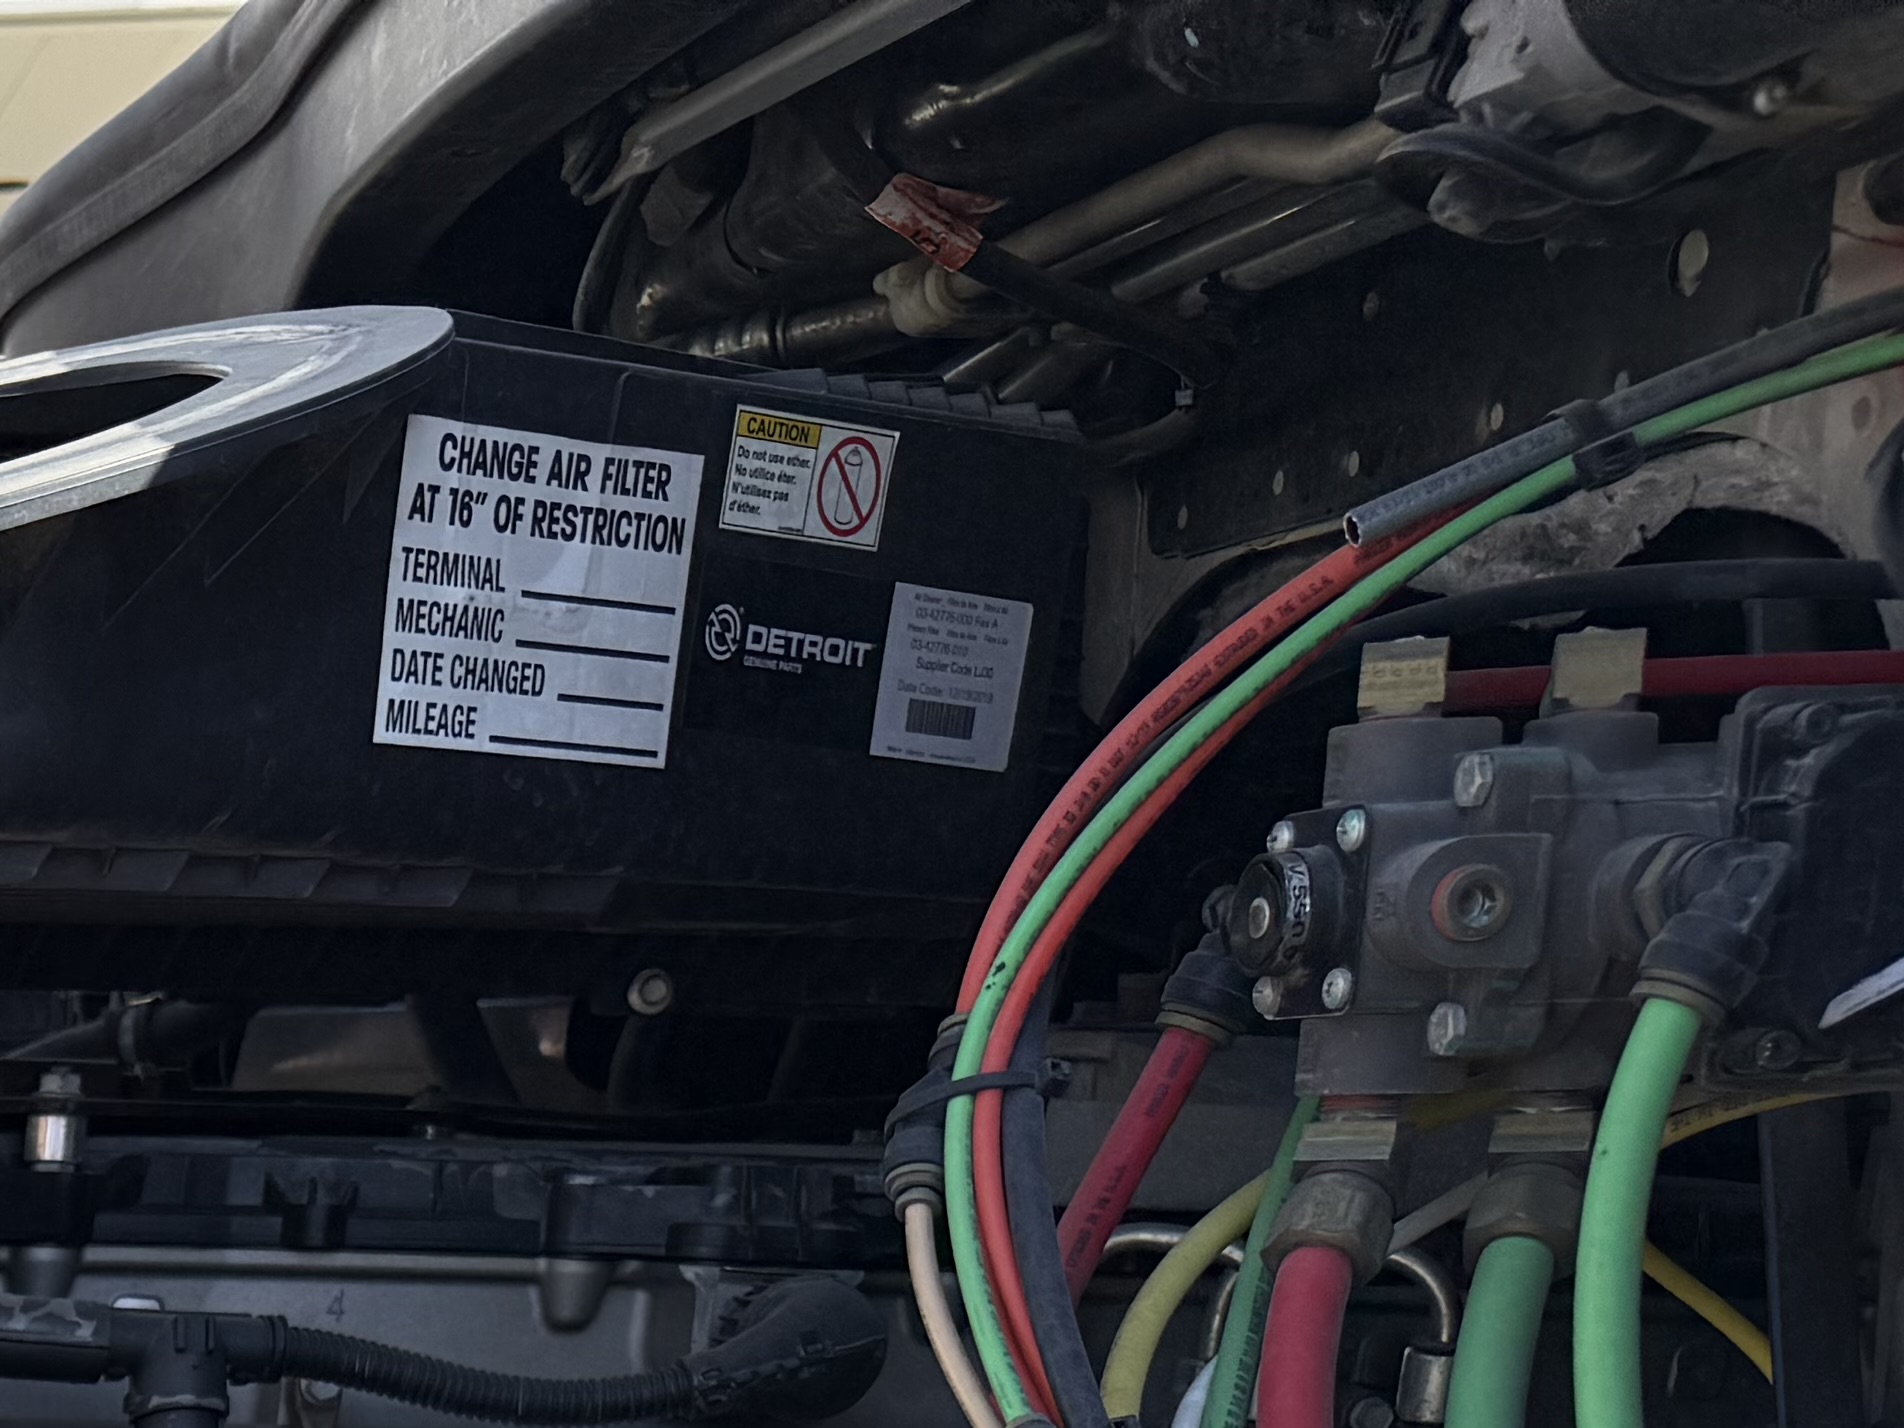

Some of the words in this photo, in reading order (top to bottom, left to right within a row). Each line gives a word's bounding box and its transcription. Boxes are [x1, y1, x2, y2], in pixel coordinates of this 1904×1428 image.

[747, 417, 811, 444] CAUTION
[438, 432, 540, 484] CHANGE
[546, 449, 592, 492] AIR
[600, 457, 672, 502] FILTER
[408, 482, 440, 523] AT
[493, 494, 525, 535] OF
[530, 499, 686, 556] RESTRICTION
[402, 546, 505, 593] TERMINAL
[395, 598, 505, 643] MECHANIC
[745, 624, 873, 668] DETROIT
[391, 648, 444, 687] DATE
[449, 654, 546, 697] CHANGED
[385, 698, 477, 740] MILEAGE
